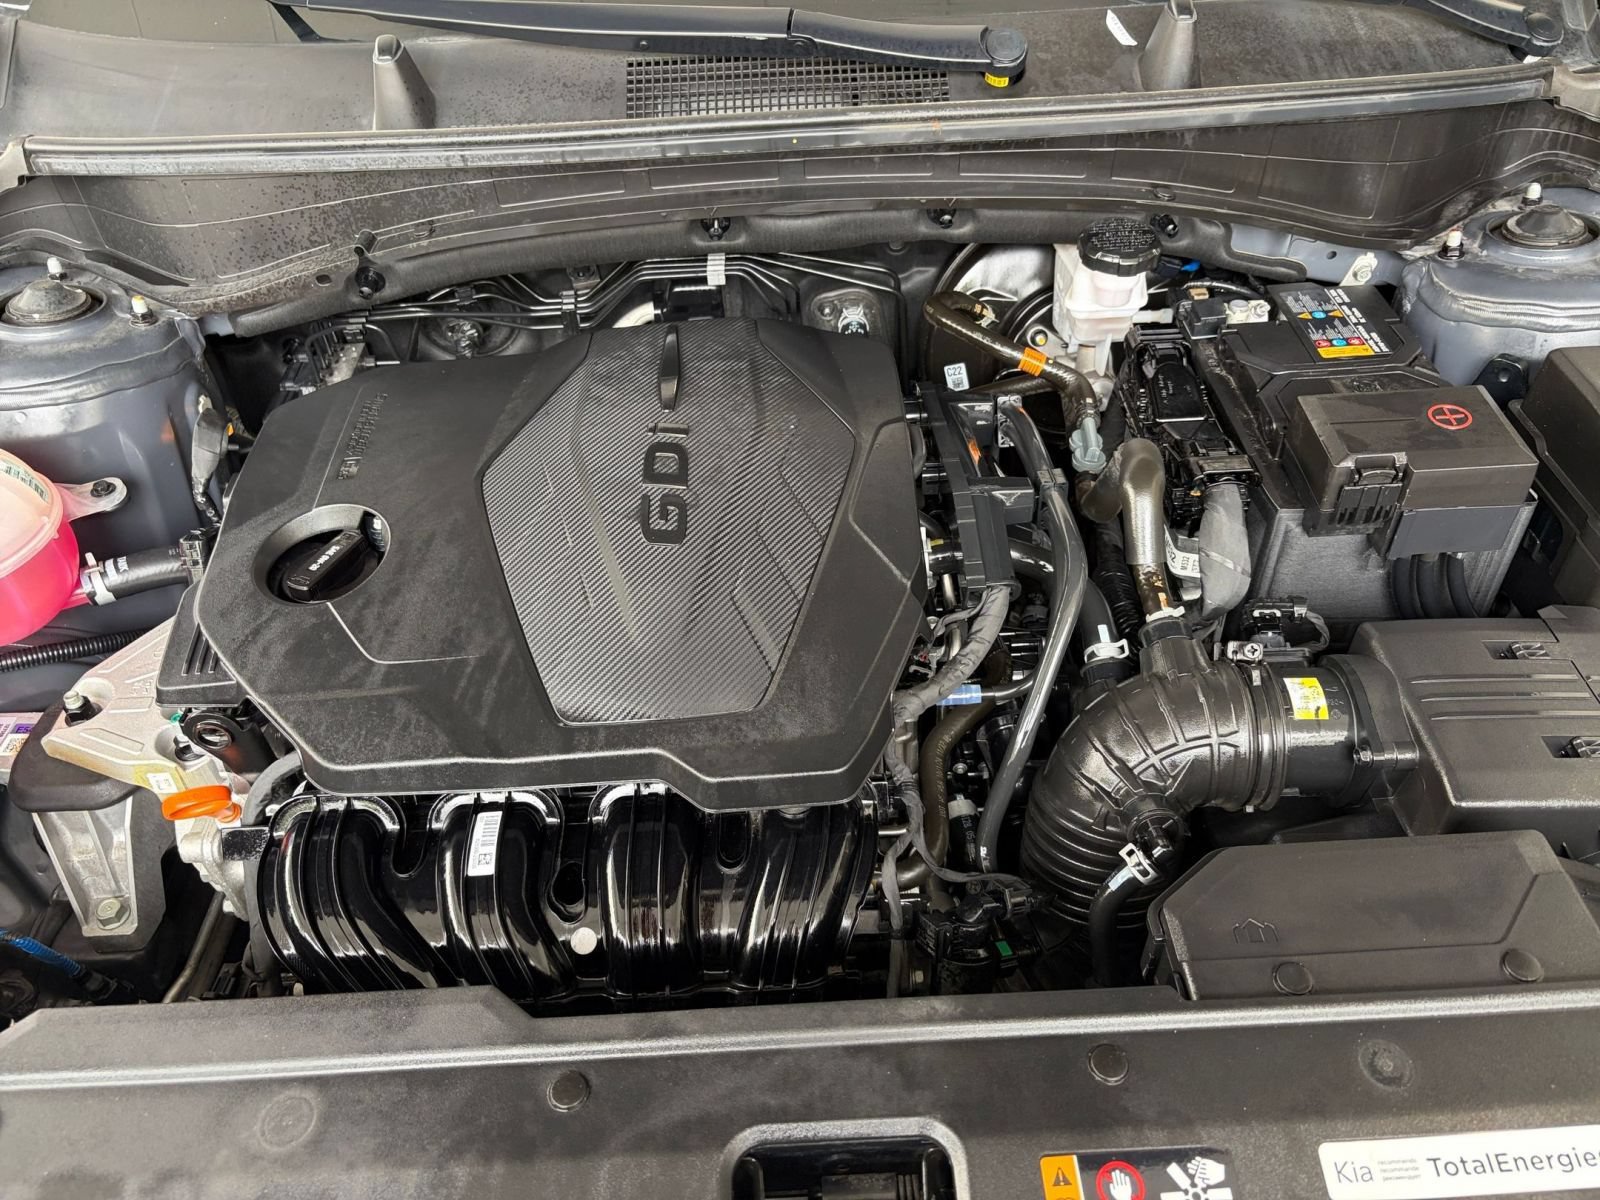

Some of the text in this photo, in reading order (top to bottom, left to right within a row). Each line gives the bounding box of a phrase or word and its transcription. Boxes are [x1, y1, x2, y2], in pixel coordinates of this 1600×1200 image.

[946, 366, 963, 377] C22
[1334, 1147, 1600, 1184] Kia TotalEnergie
